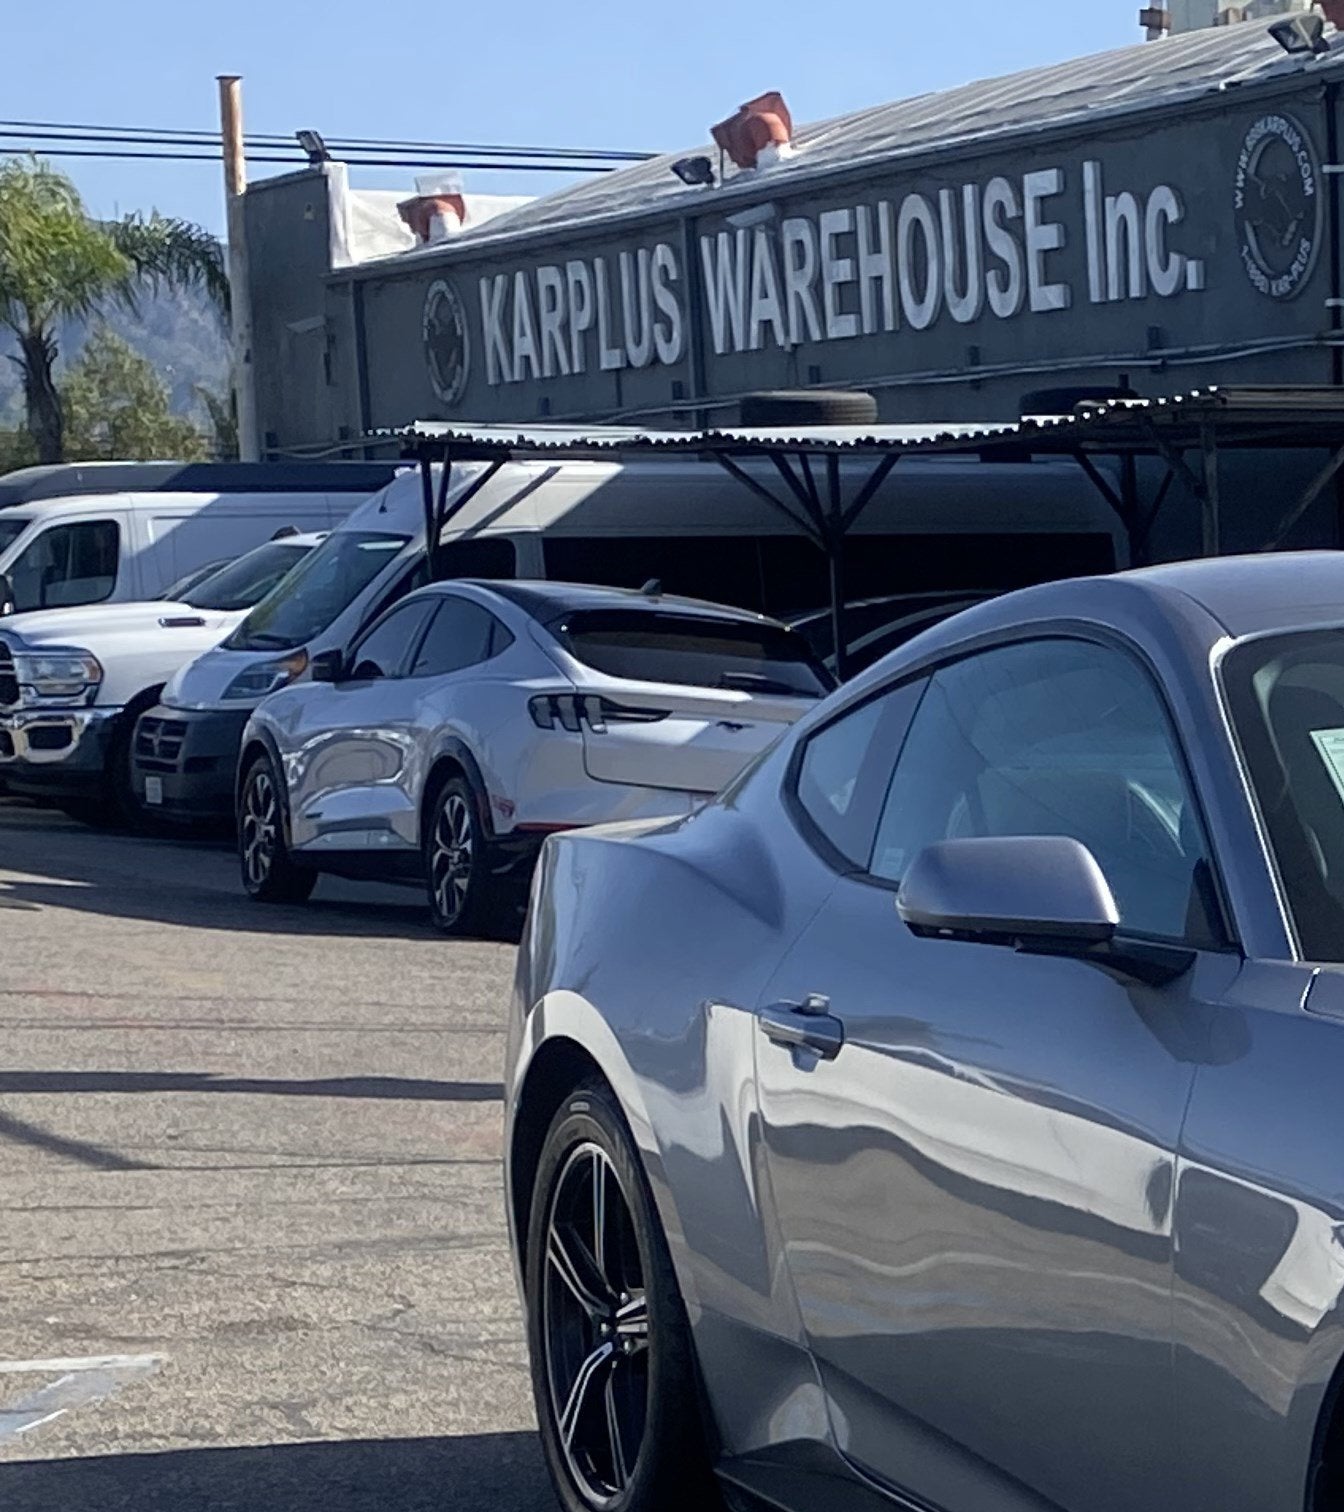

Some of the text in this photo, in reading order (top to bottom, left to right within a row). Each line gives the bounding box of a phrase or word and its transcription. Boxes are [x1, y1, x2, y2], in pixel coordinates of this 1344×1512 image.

[479, 244, 685, 385] KARPLUS
[700, 167, 1072, 355] WAREHOUSE
[1083, 161, 1203, 303] Inc.
